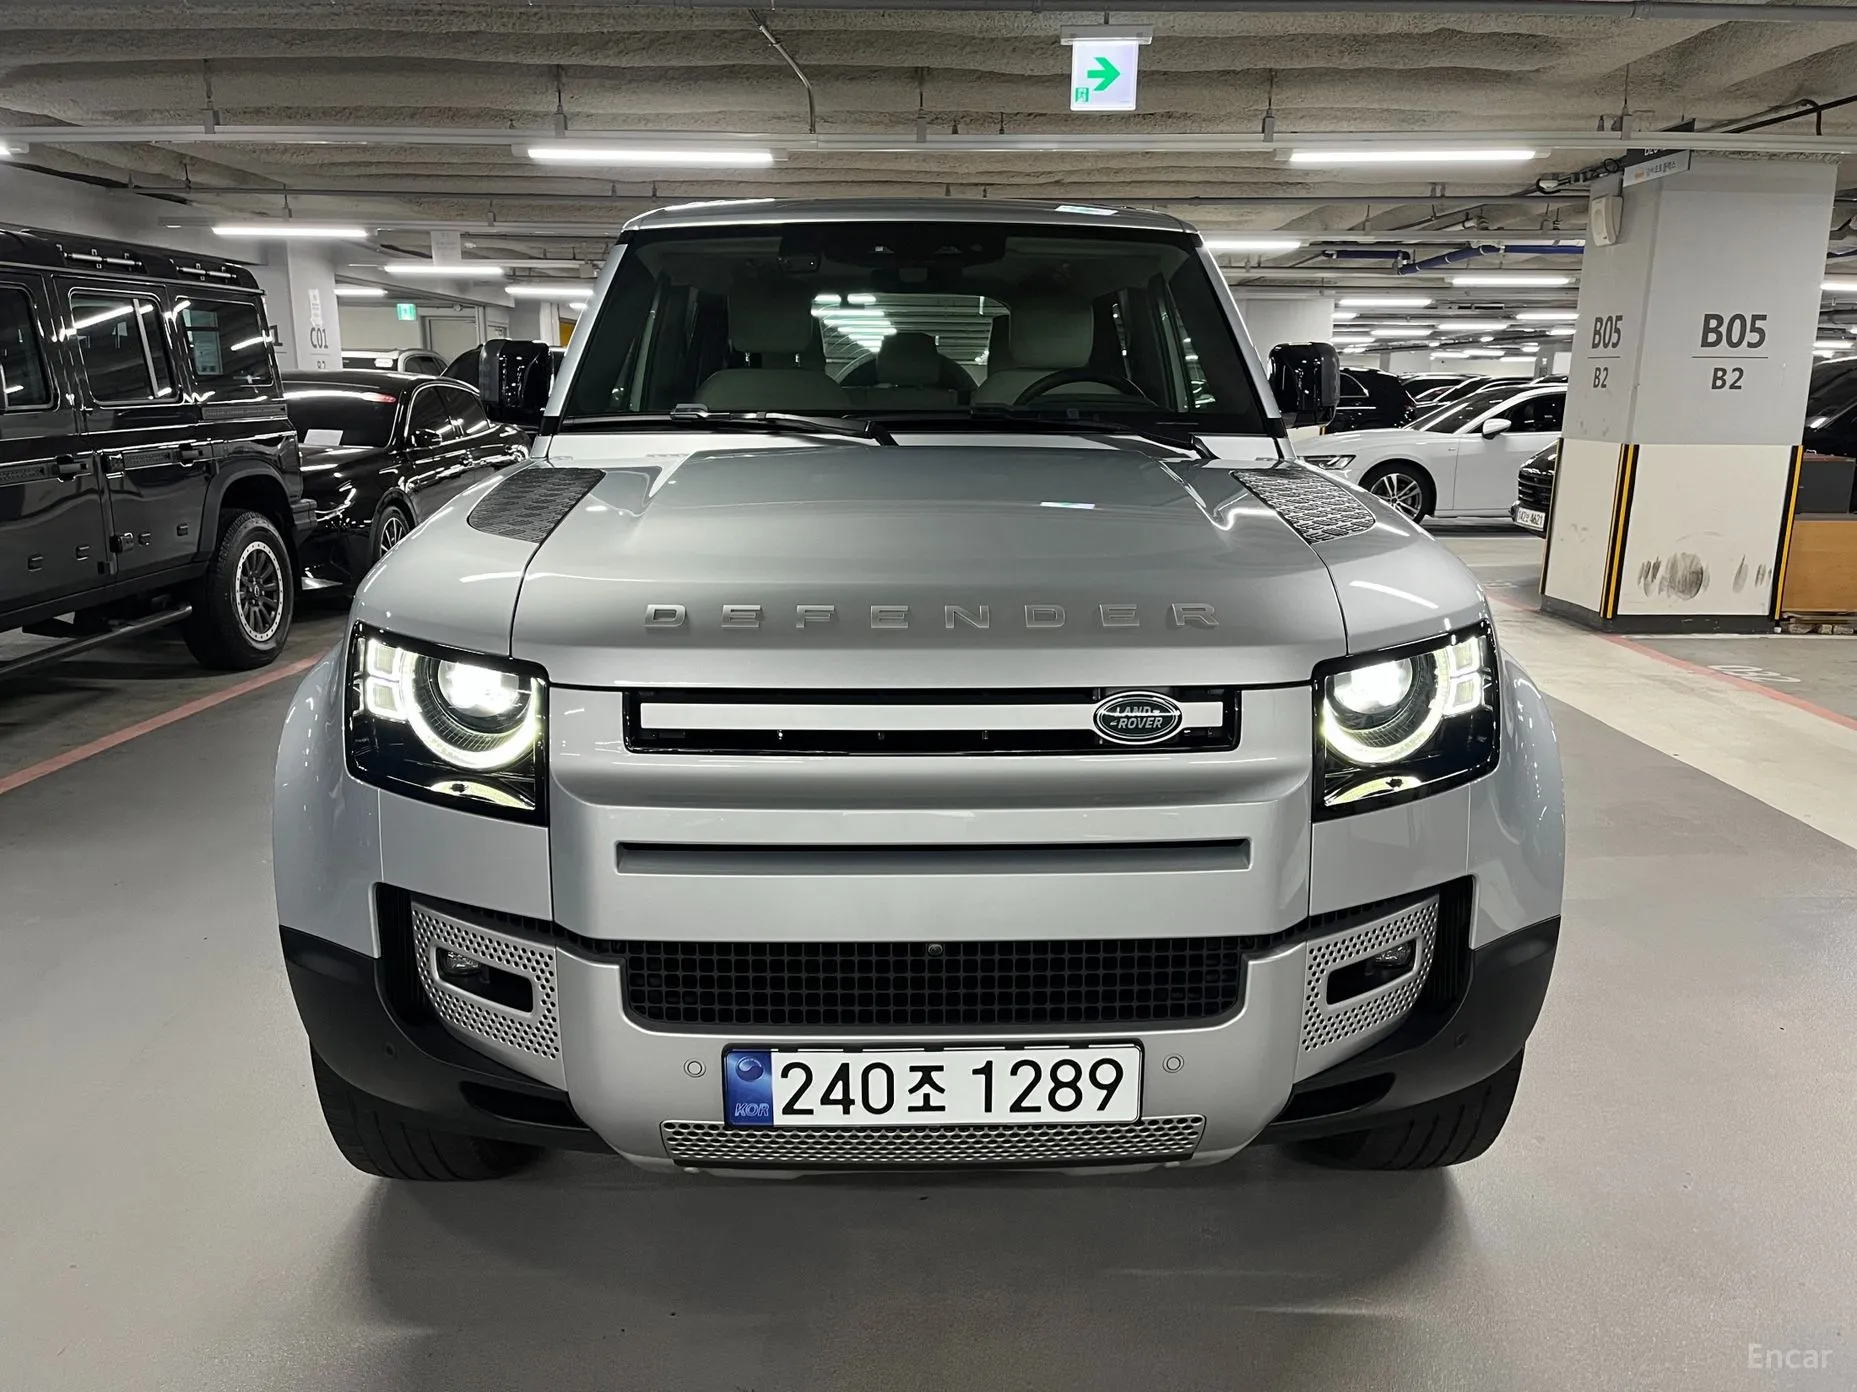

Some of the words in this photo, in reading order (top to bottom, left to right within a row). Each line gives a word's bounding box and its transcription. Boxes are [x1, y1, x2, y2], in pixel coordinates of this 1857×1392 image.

[310, 327, 329, 349] C01
[1592, 315, 1623, 349] B05
[1700, 313, 1768, 349] B05
[1593, 367, 1609, 389] B2
[1711, 367, 1745, 390] B2
[645, 603, 1219, 629] DEFENDER
[1115, 706, 1152, 716] LAND
[1118, 717, 1163, 729] ROVER
[780, 1061, 946, 1116] 240조
[971, 1057, 1124, 1113] 1289
[734, 1103, 770, 1117] KOR
